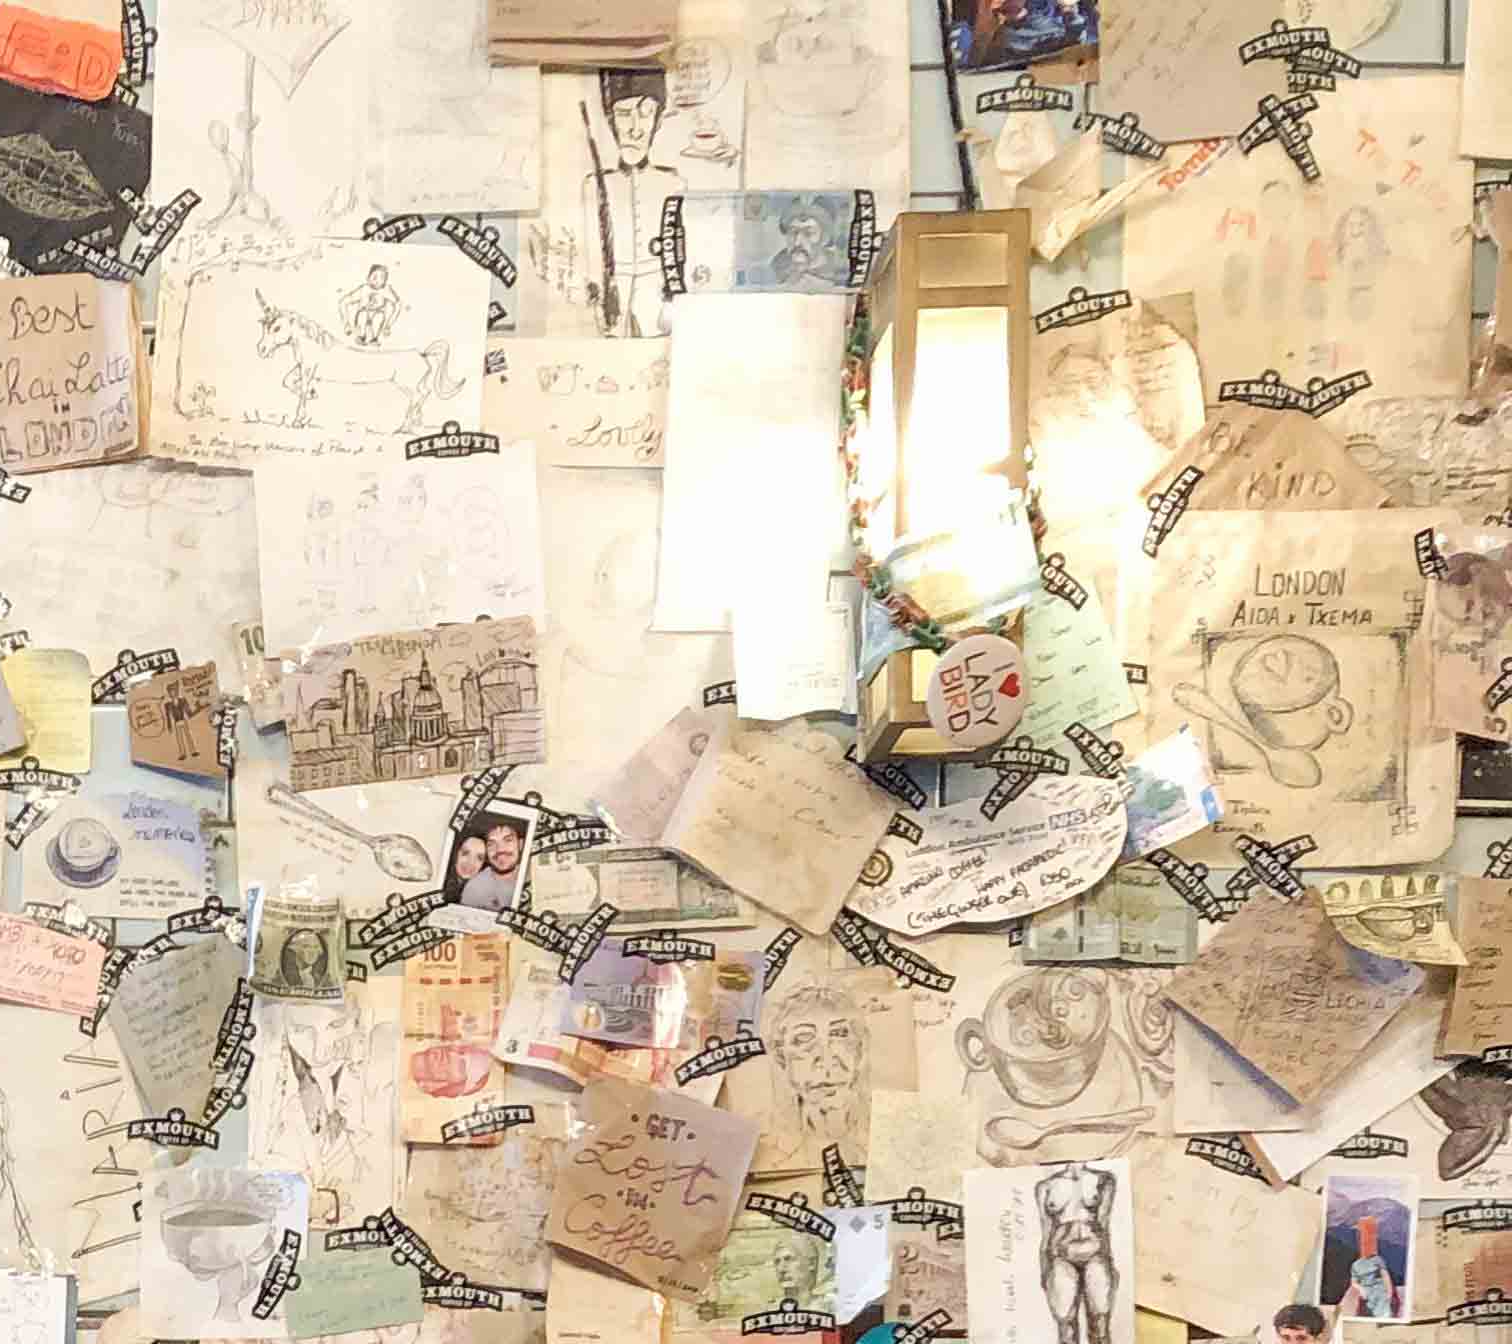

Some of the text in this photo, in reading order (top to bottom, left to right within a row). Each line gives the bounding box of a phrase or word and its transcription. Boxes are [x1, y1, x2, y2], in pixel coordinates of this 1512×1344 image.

[1241, 30, 1329, 62] EXMOUTH
[439, 217, 516, 286] EXMOUTH
[662, 197, 686, 293] EXMOUTH
[851, 190, 873, 287] EXMOUTH
[8, 290, 95, 341] Best
[1037, 292, 1131, 331] EXMOUTH
[407, 433, 498, 458] EXMOUTH
[1255, 563, 1346, 598] LONDON
[962, 650, 1000, 728] LADY
[624, 938, 714, 960] EXMOUTH
[675, 1039, 764, 1084] EXMOUTH
[129, 1122, 218, 1147] EXMOUTH
[441, 1105, 534, 1142] EXMOUTH
[645, 1115, 689, 1139] GET
[564, 1194, 684, 1265] Coffee
[747, 1193, 835, 1241] EXMOUTH
[743, 1314, 833, 1331] EXMOUTH
